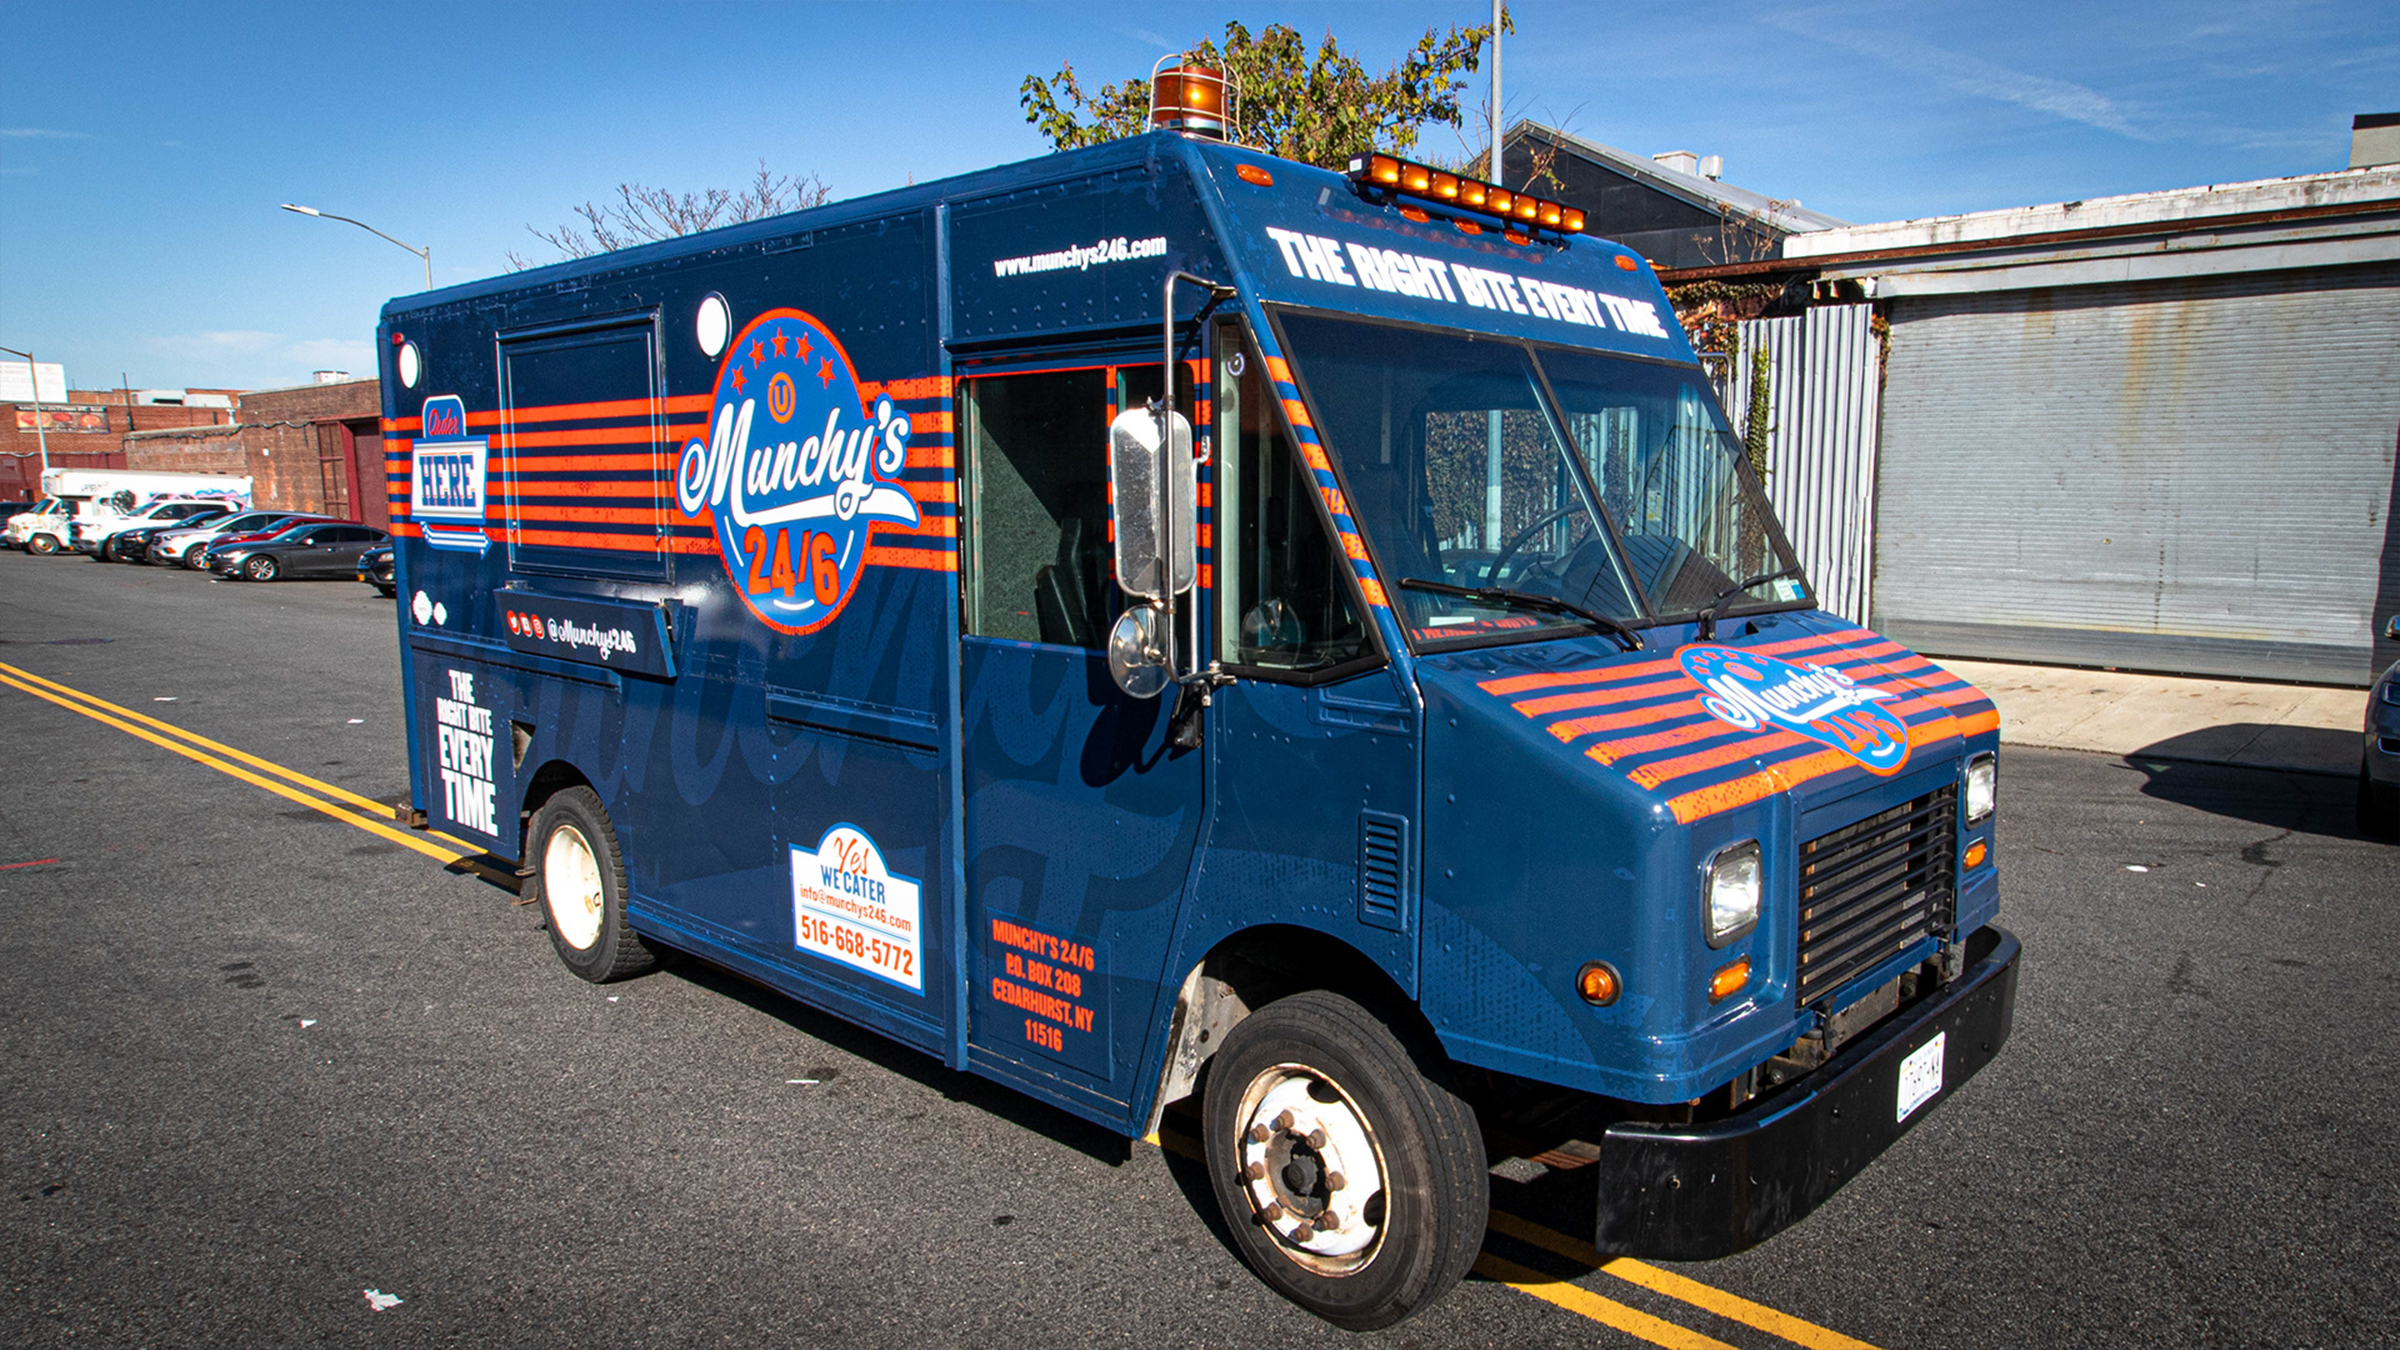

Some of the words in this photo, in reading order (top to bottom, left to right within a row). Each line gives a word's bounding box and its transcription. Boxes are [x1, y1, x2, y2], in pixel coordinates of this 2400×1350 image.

[994, 236, 1168, 277] www.munchys246.com
[1265, 226, 1358, 287] THE
[1345, 241, 1459, 304] RIGHT
[1450, 262, 1528, 316] BITE
[1517, 276, 1606, 329] EVERY
[1598, 292, 1670, 339] TIME
[428, 408, 459, 436] Order
[418, 451, 477, 507] HERE
[679, 398, 915, 527] Munchy's
[744, 525, 840, 606] 24/6
[448, 669, 475, 704] THE
[1706, 663, 1897, 728] Munchy's
[436, 697, 469, 730] RIGHT
[468, 704, 494, 736] BITE
[1810, 710, 1905, 754] 24/6
[437, 723, 494, 781] EVERY
[440, 767, 499, 837] TIME
[833, 836, 869, 876] Yes
[800, 883, 912, 932] info@munchys246.com
[820, 864, 841, 891] WE
[843, 871, 886, 905] CATER
[801, 914, 914, 976] 516-668-5772
[992, 918, 1059, 960] MUNCHY'S
[1060, 939, 1095, 971] 24/6
[1027, 959, 1053, 988] BOX
[1054, 968, 1082, 998] 208
[992, 977, 1074, 1028] CEDARHURST,
[1074, 1005, 1095, 1033] NY
[1024, 1018, 1063, 1052] 11516
